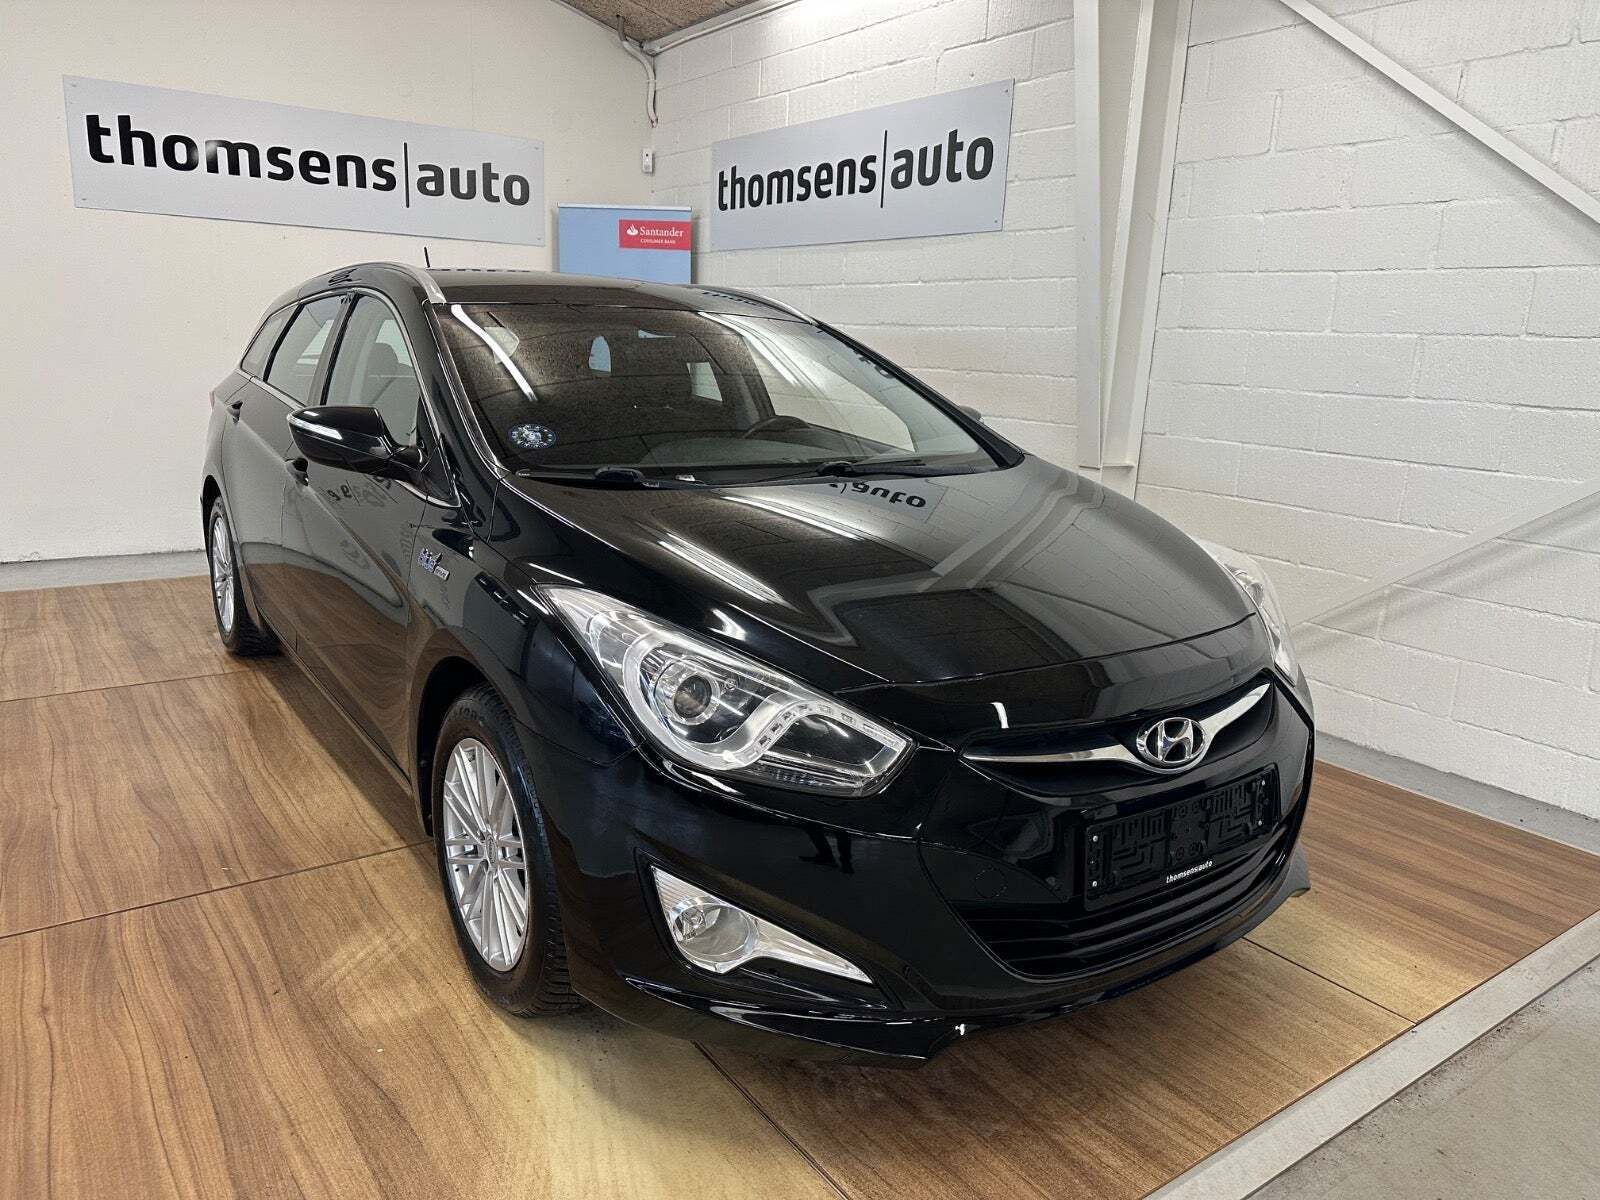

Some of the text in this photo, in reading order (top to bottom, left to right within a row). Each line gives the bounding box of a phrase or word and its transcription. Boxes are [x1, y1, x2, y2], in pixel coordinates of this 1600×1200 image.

[86, 114, 530, 206] thomsens auto
[718, 129, 994, 211] thomsens auto
[640, 226, 684, 237] Santander
